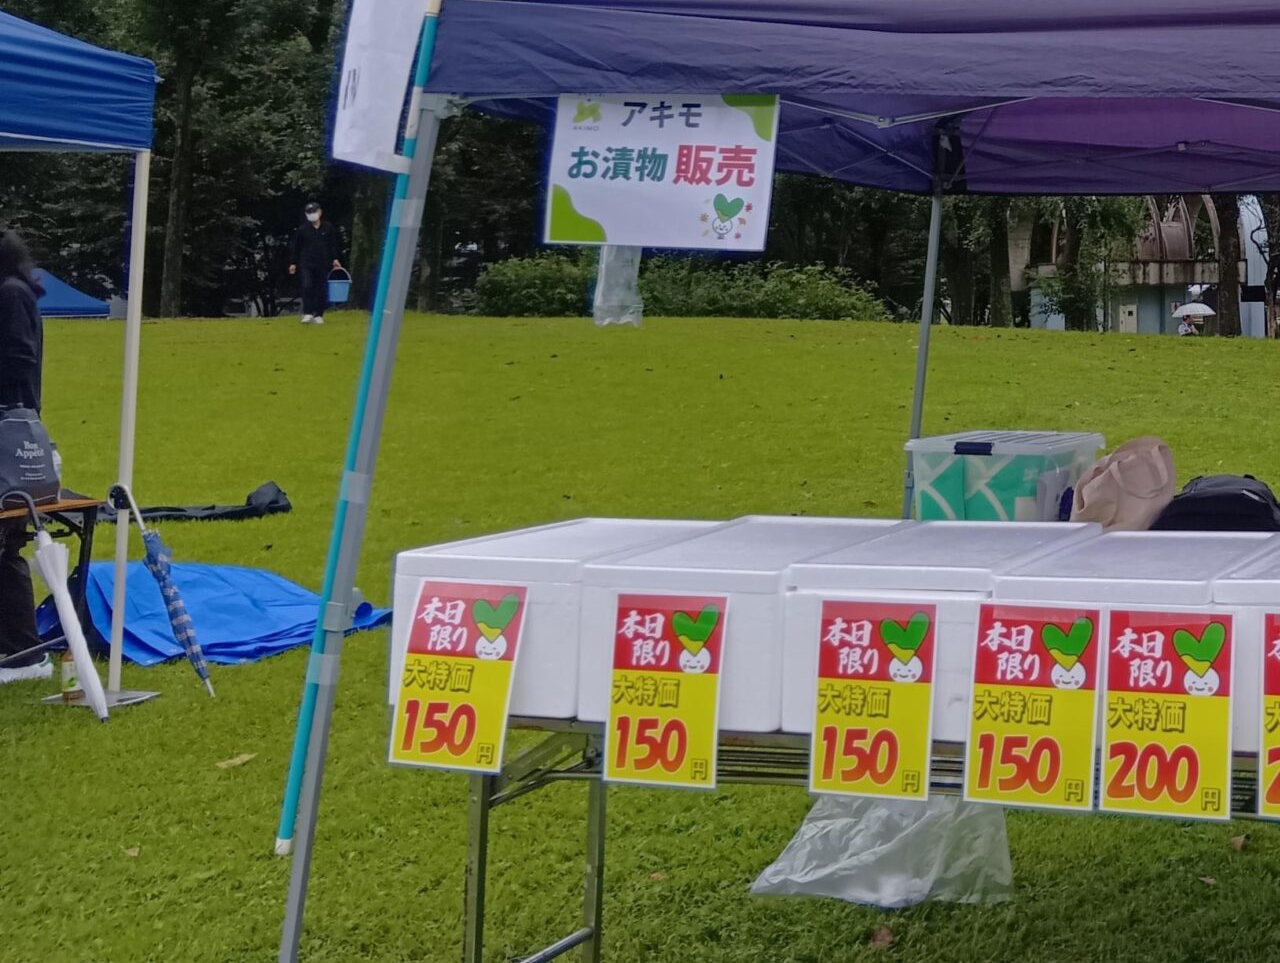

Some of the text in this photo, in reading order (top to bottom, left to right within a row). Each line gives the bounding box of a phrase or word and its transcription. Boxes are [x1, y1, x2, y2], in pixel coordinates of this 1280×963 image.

[621, 101, 703, 128] アキモ
[417, 595, 465, 625] 本日
[617, 609, 666, 639] 本日
[428, 624, 467, 652] 限り
[822, 617, 872, 647] 本日
[980, 621, 1034, 652] 本日
[1111, 627, 1165, 658] 本日
[632, 638, 671, 667] 限り
[837, 646, 879, 675] 限り
[996, 652, 1041, 682] 限り
[402, 659, 475, 694] 大特価
[1128, 658, 1173, 689] 限り
[613, 676, 680, 708] 大特価
[818, 684, 891, 718] 大特価
[974, 690, 1052, 725] 大特価
[1108, 697, 1186, 732] 大特価
